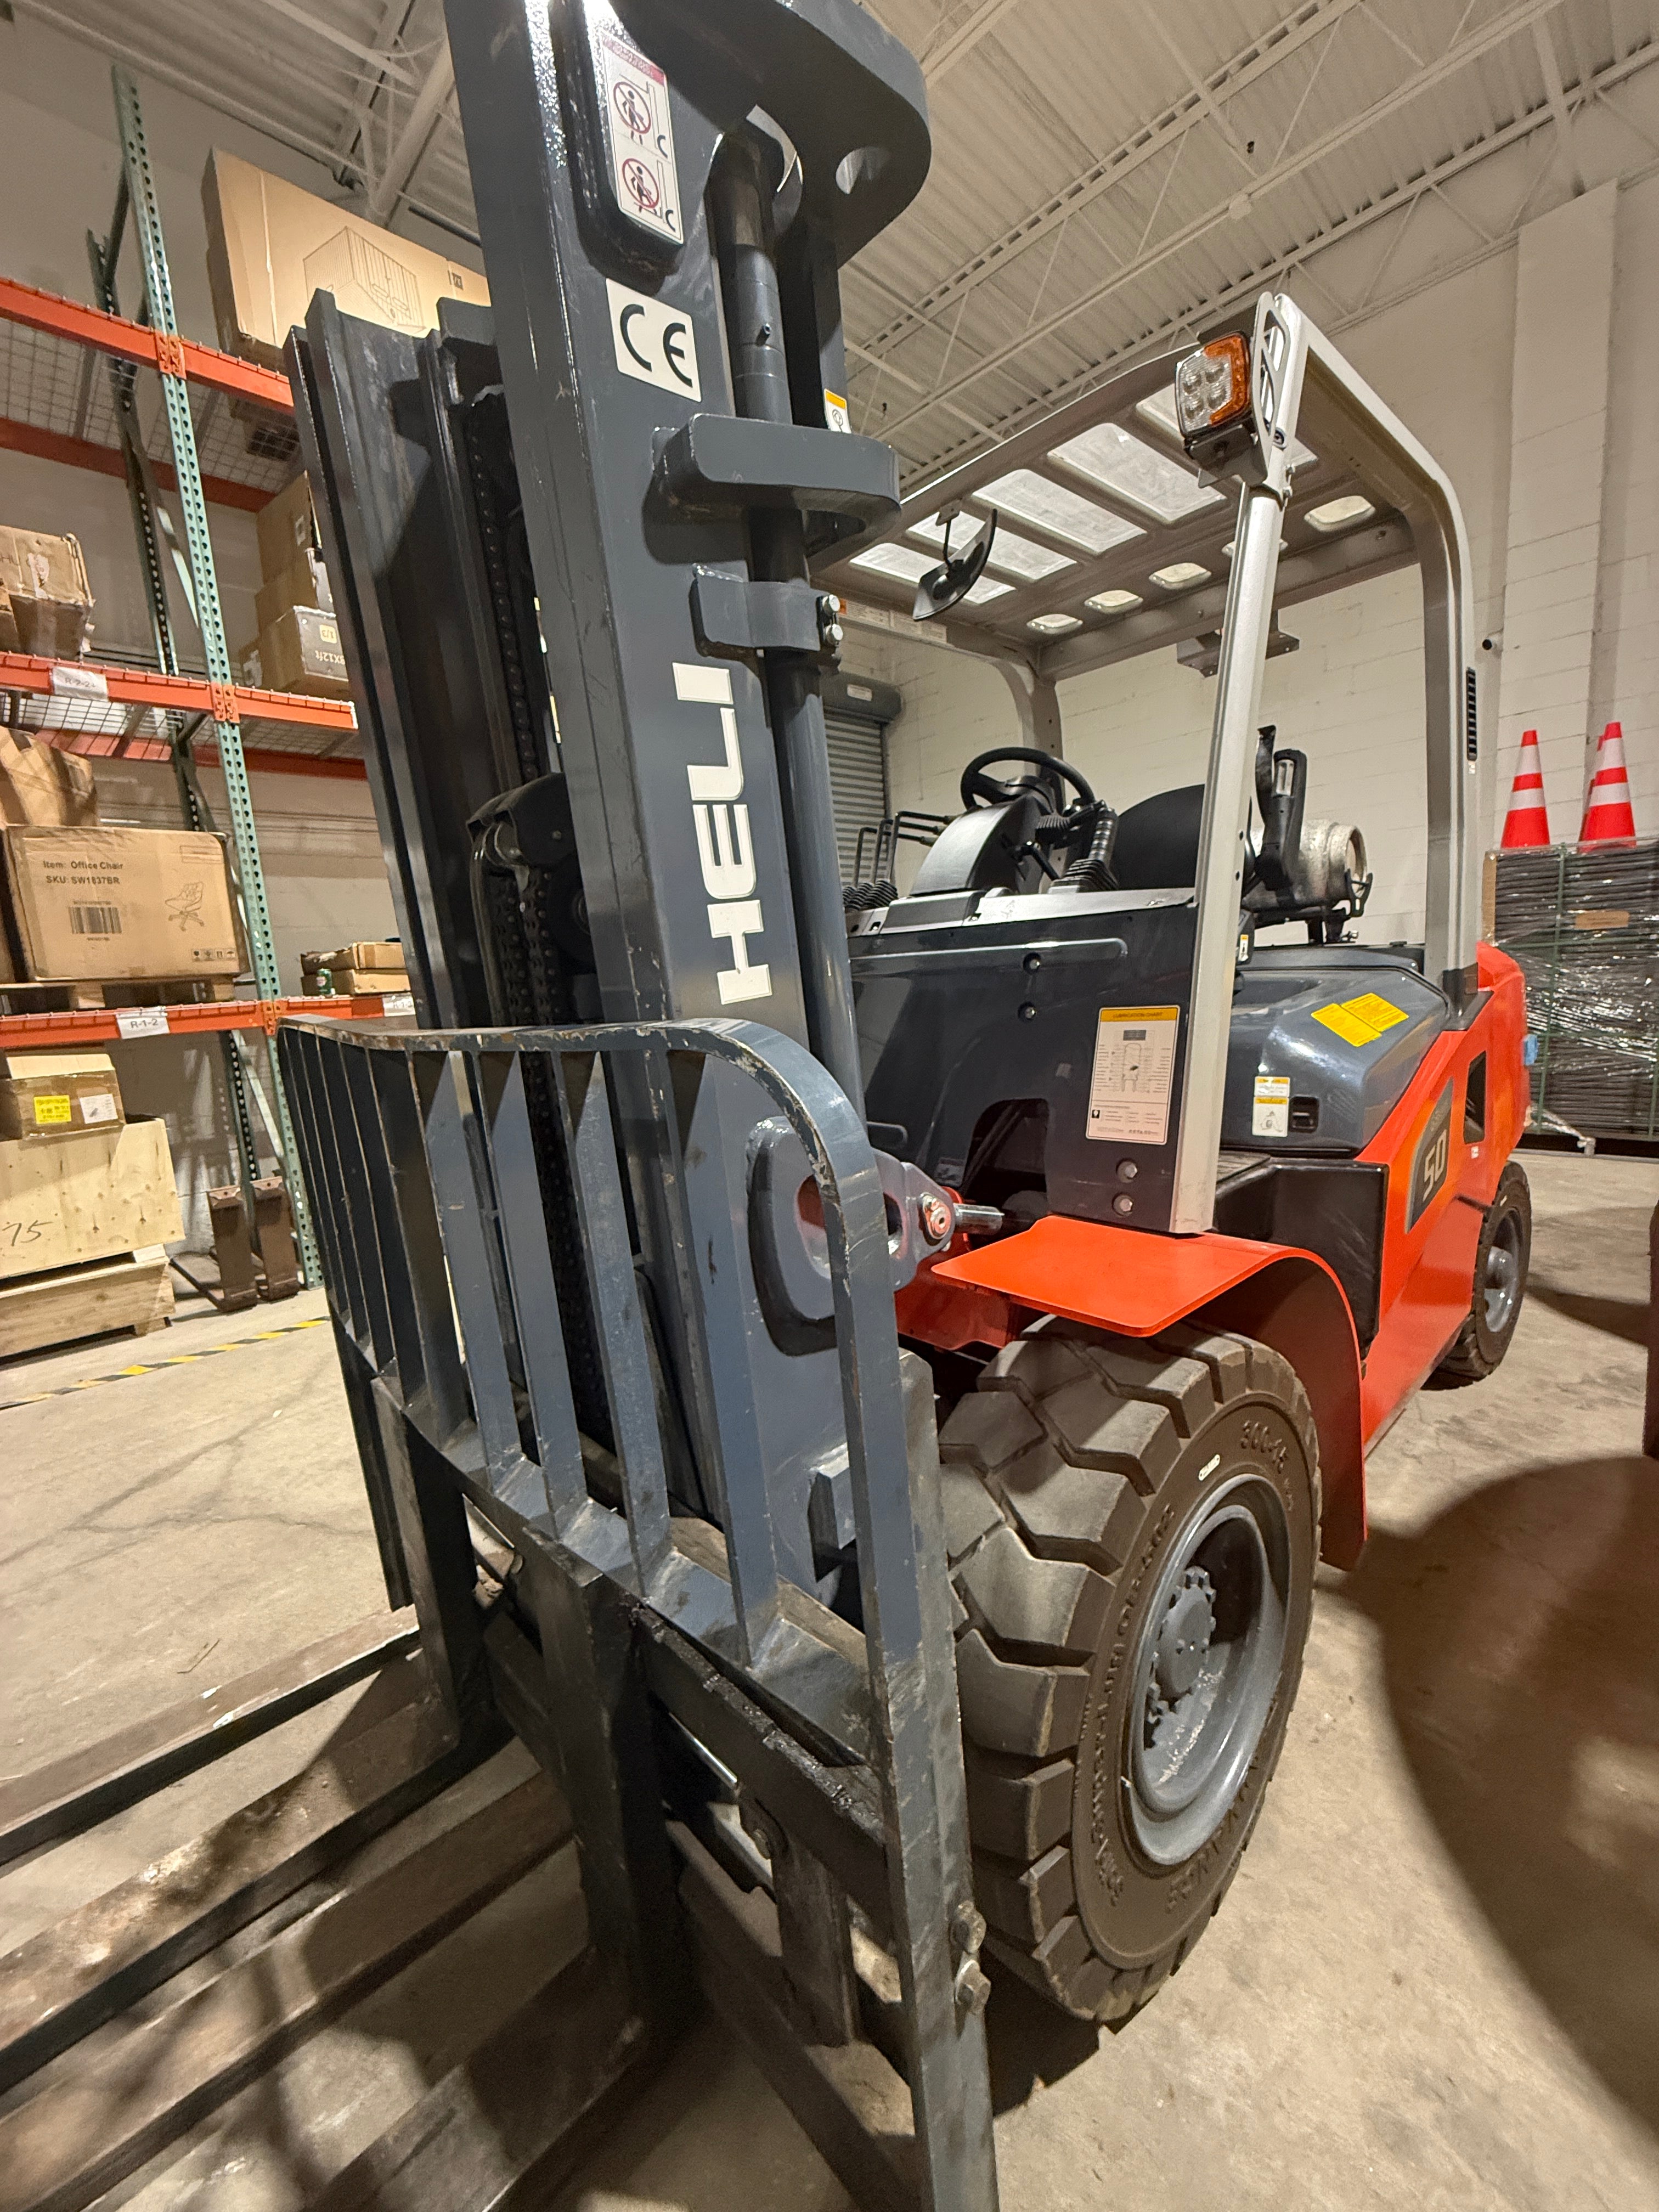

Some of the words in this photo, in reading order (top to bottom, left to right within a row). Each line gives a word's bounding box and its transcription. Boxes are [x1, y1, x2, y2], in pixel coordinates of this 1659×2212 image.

[619, 303, 693, 388] CE
[70, 861, 98, 870] Office
[99, 861, 123, 870] Chair
[672, 662, 772, 1005] HELI
[130, 1018, 159, 1029] R-1-2
[1422, 1128, 1447, 1203] 50
